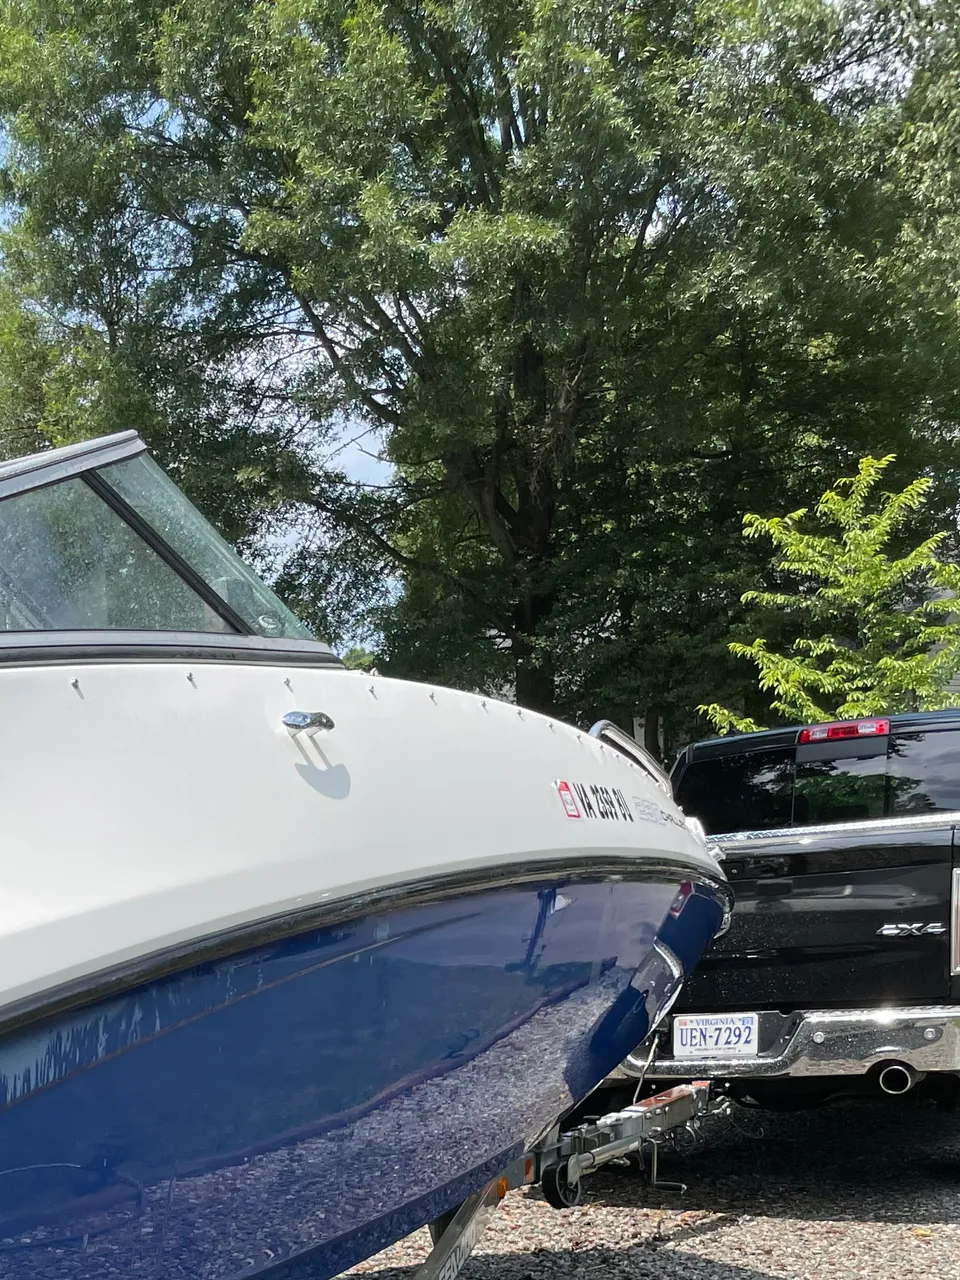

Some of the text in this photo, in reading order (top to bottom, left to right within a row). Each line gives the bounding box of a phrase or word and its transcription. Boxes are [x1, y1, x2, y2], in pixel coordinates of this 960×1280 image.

[572, 782, 597, 819] VA
[695, 1017, 736, 1027] VIRGINIA
[679, 1025, 753, 1047] UEN-7292
